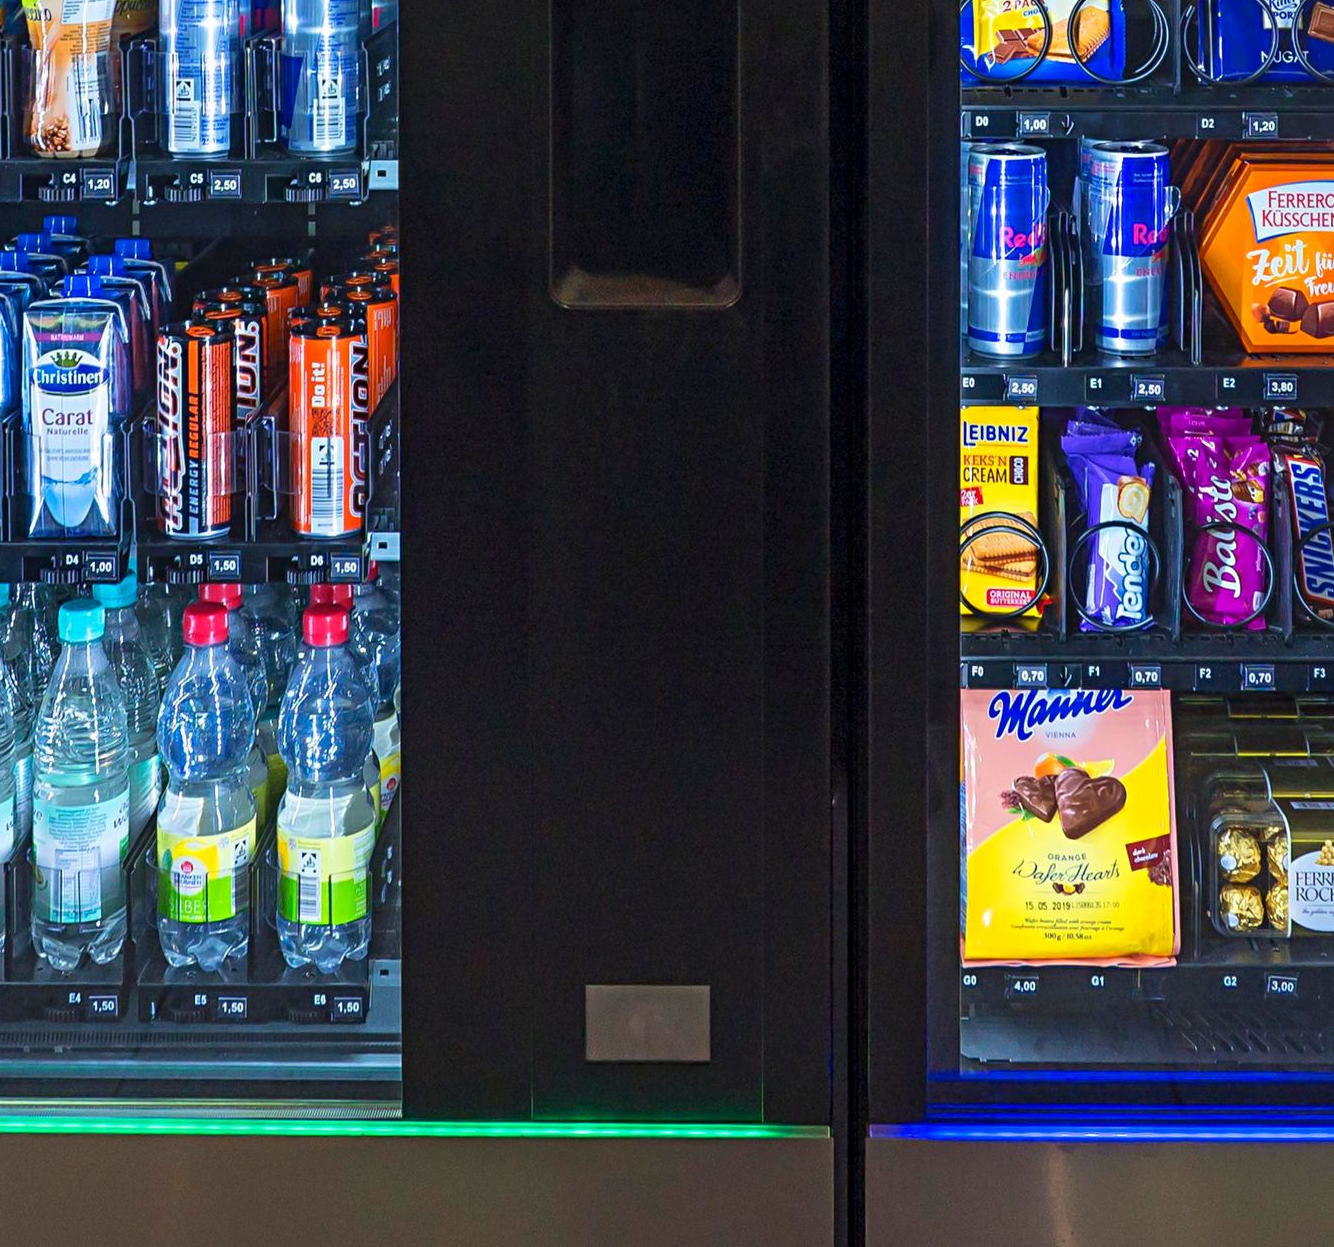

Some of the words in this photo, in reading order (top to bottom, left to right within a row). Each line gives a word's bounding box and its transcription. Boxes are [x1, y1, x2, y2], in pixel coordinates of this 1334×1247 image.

[1201, 119, 1215, 129] D2
[1253, 121, 1275, 132] 1,20
[1247, 240, 1311, 284] Zeit
[32, 369, 103, 387] Christinen
[1223, 378, 1235, 388] E2
[1271, 382, 1293, 393] 3,80
[311, 385, 325, 408] Do
[42, 408, 94, 428] Carat
[190, 394, 201, 458] REGULAR
[46, 427, 89, 436] Naturelle
[963, 422, 1029, 447] LEIBNIZ
[963, 468, 1008, 484] CREAM
[189, 459, 200, 519] ENERGY
[190, 555, 203, 565] D5
[214, 560, 236, 571] 1,50
[989, 590, 1031, 600] ORIGINAL
[988, 689, 1135, 741] Manner
[1045, 730, 1077, 740] VIENNA
[1047, 853, 1087, 862] ORANGE
[1013, 859, 1065, 885] Wafer
[1067, 859, 1120, 882] Hearts
[1224, 976, 1237, 987] G2
[1271, 981, 1294, 993] 3,00
[314, 995, 326, 1005] E6
[337, 1002, 360, 1014] 1,50
